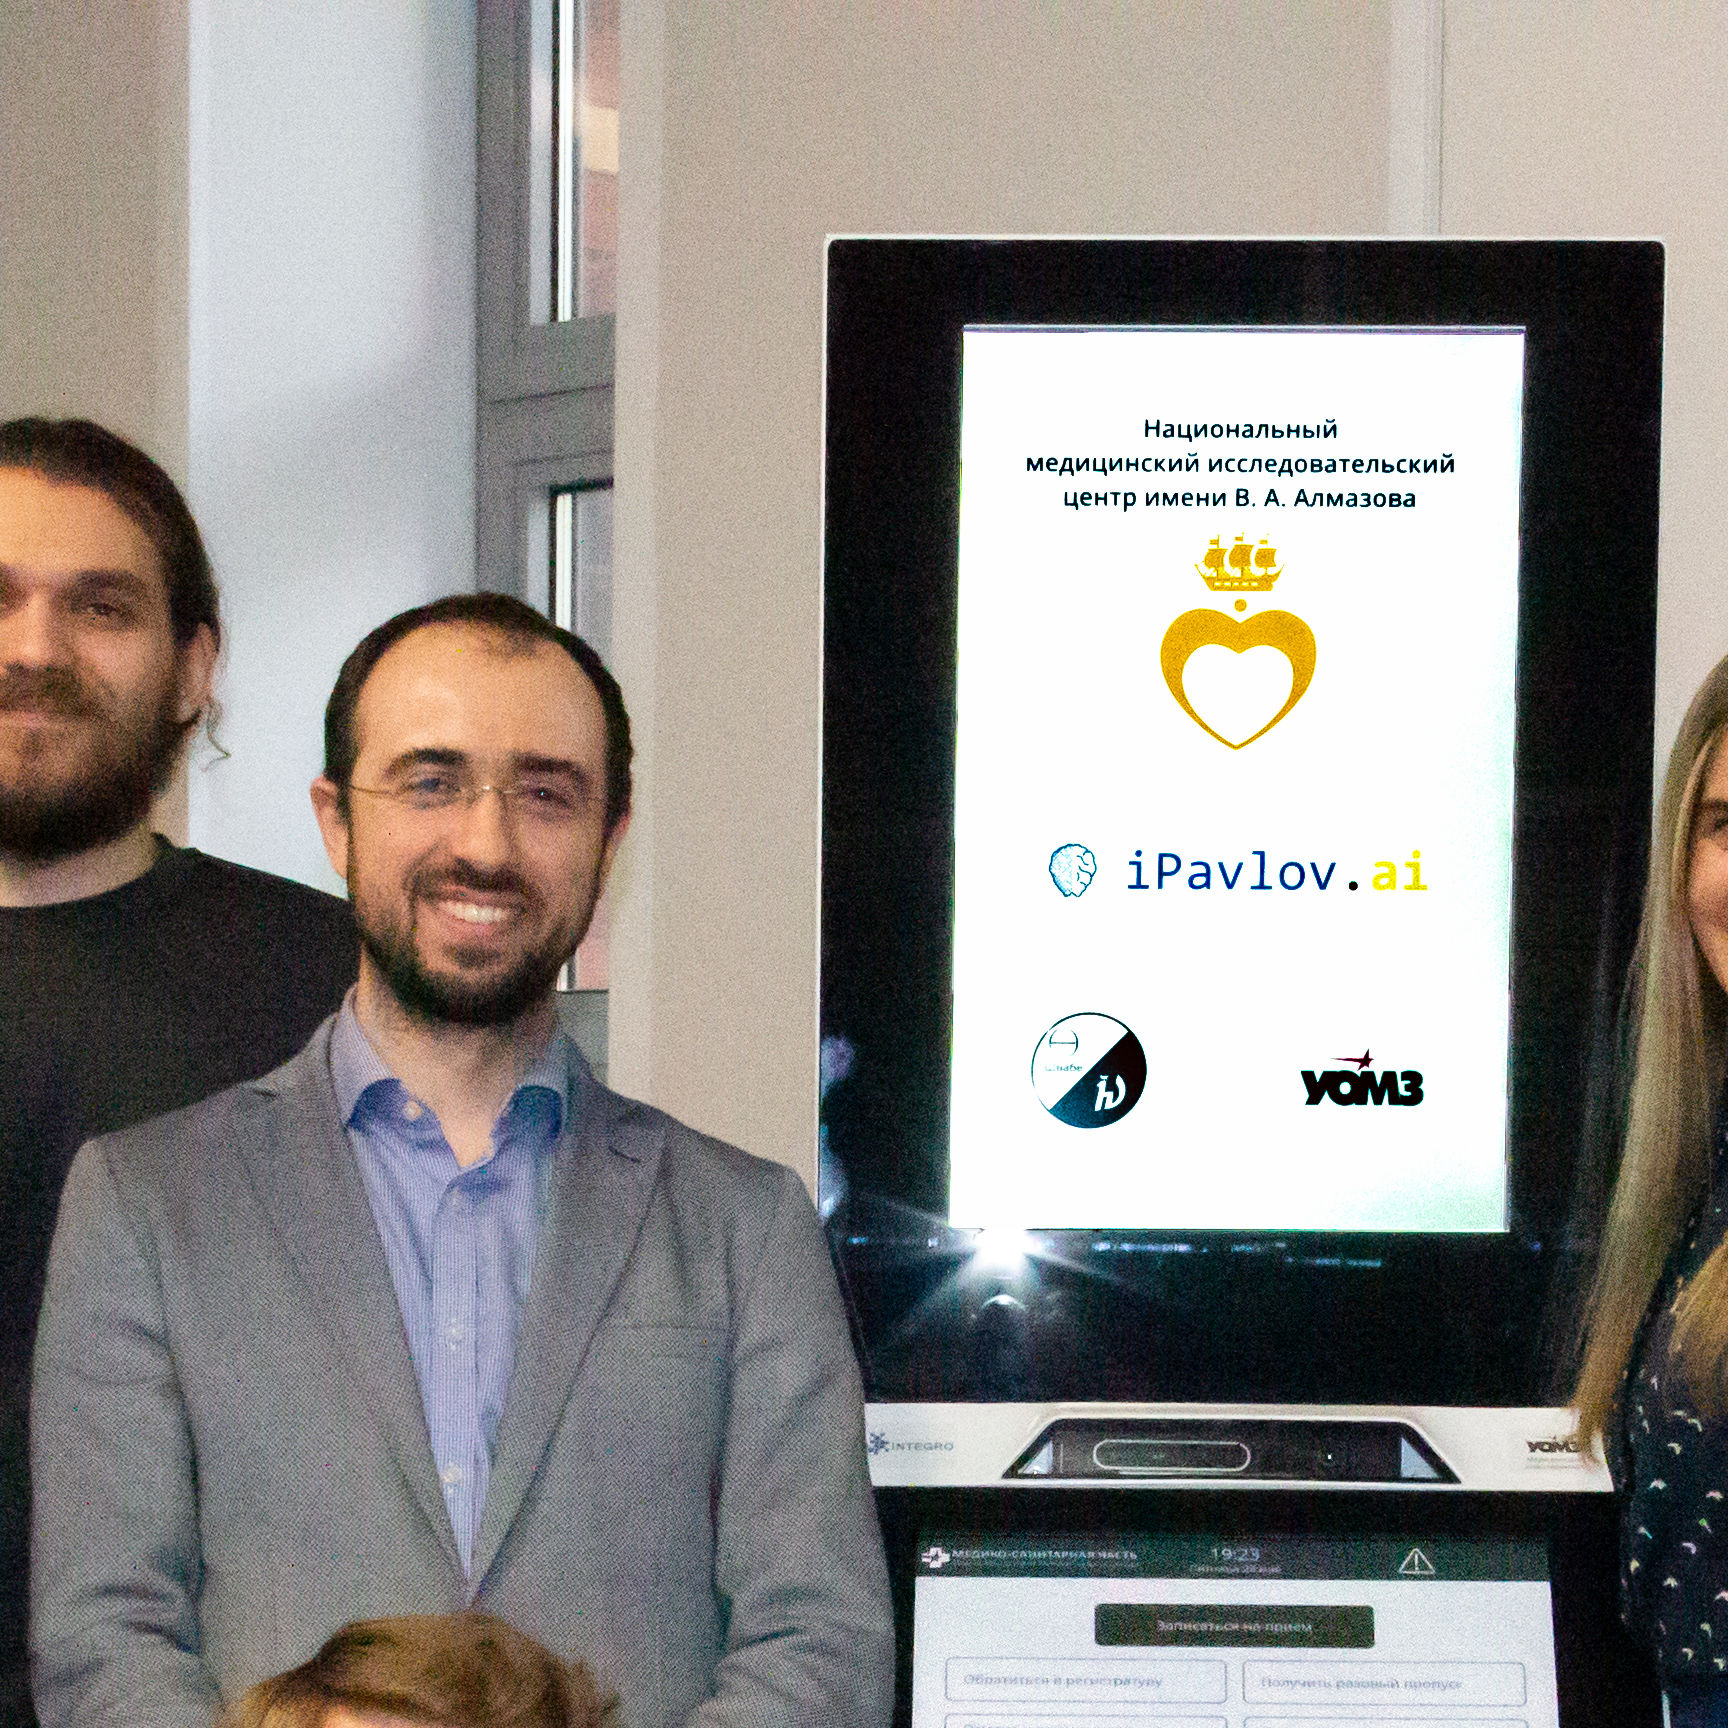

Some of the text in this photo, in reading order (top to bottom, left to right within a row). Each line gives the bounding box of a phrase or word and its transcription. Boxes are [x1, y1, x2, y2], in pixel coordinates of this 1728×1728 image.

[1145, 419, 1337, 442] Национальный
[1027, 453, 1454, 477] медицинский исследовательский
[1064, 488, 1415, 512] центр имени В. А. Алмазова
[1128, 850, 1427, 891] iPavlov.ai
[891, 1442, 955, 1451] INTEGRO
[1157, 1620, 1239, 1632] Записаться
[1242, 1623, 1261, 1631] на
[963, 1674, 1049, 1686] Обратиться
[1066, 1677, 1162, 1689] регистратуру
[1261, 1678, 1462, 1692] Получить разовый пропуск
